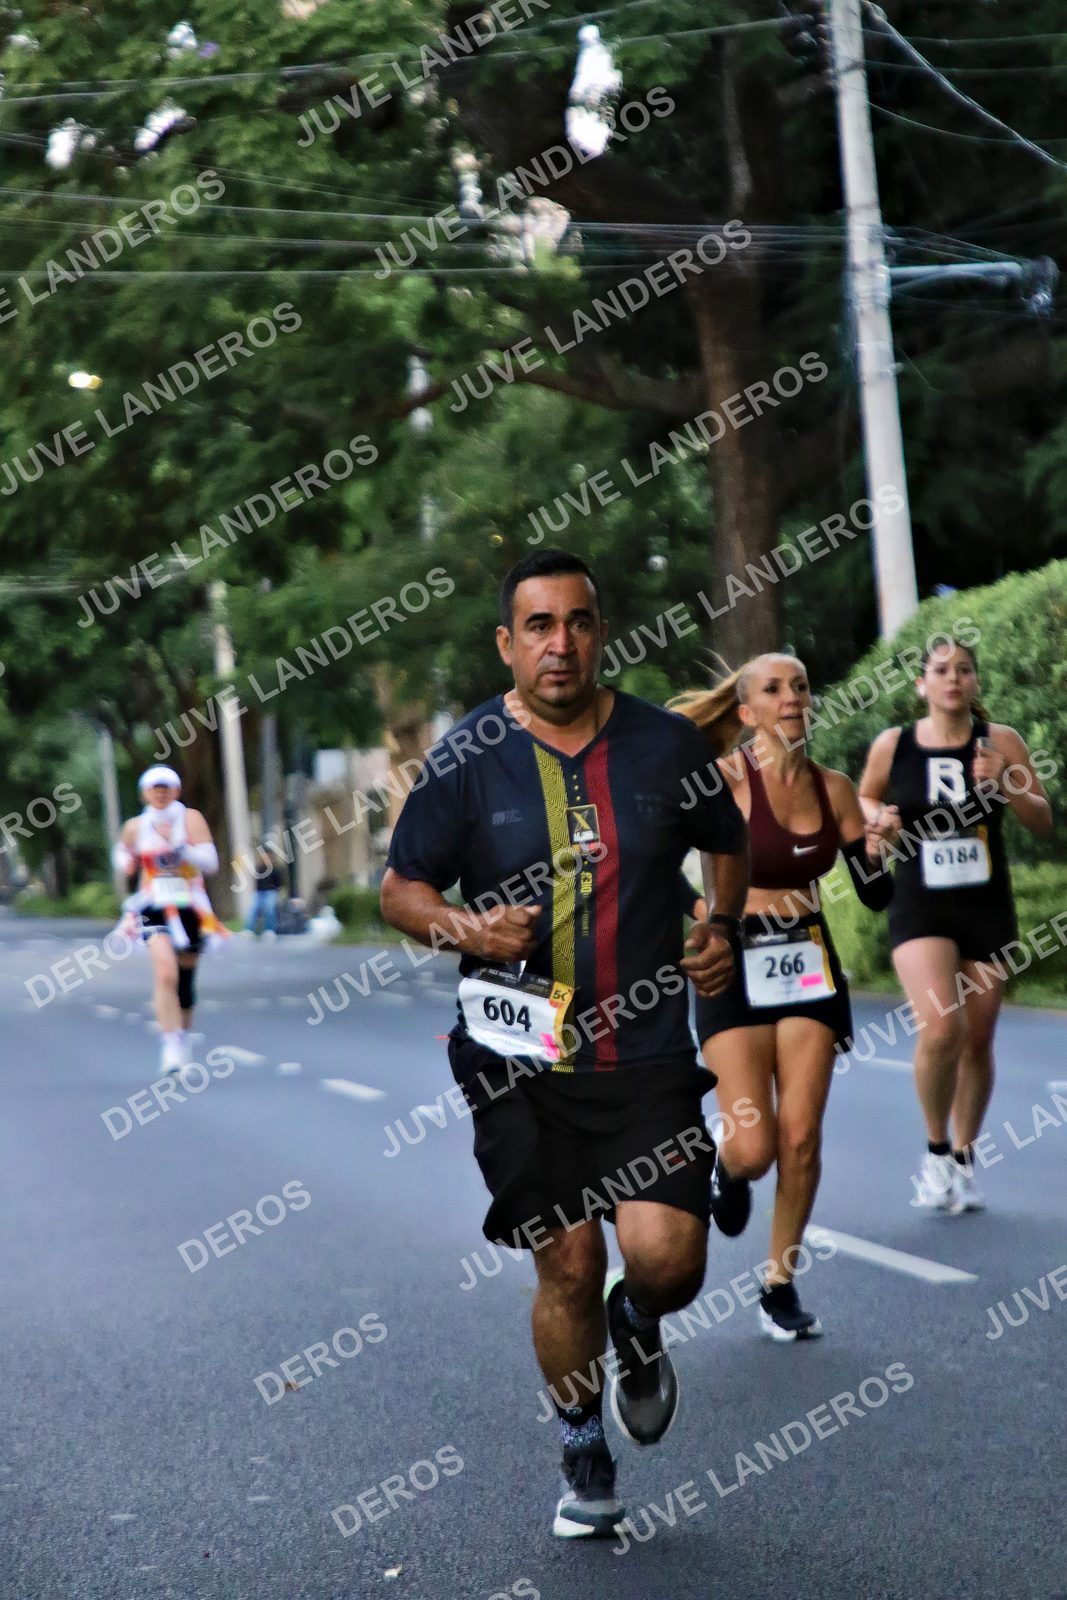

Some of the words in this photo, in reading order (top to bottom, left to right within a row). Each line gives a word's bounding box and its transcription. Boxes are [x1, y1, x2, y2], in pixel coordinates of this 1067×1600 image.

[933, 845, 979, 866] 6184
[764, 952, 806, 979] 266
[483, 996, 532, 1032] 604
